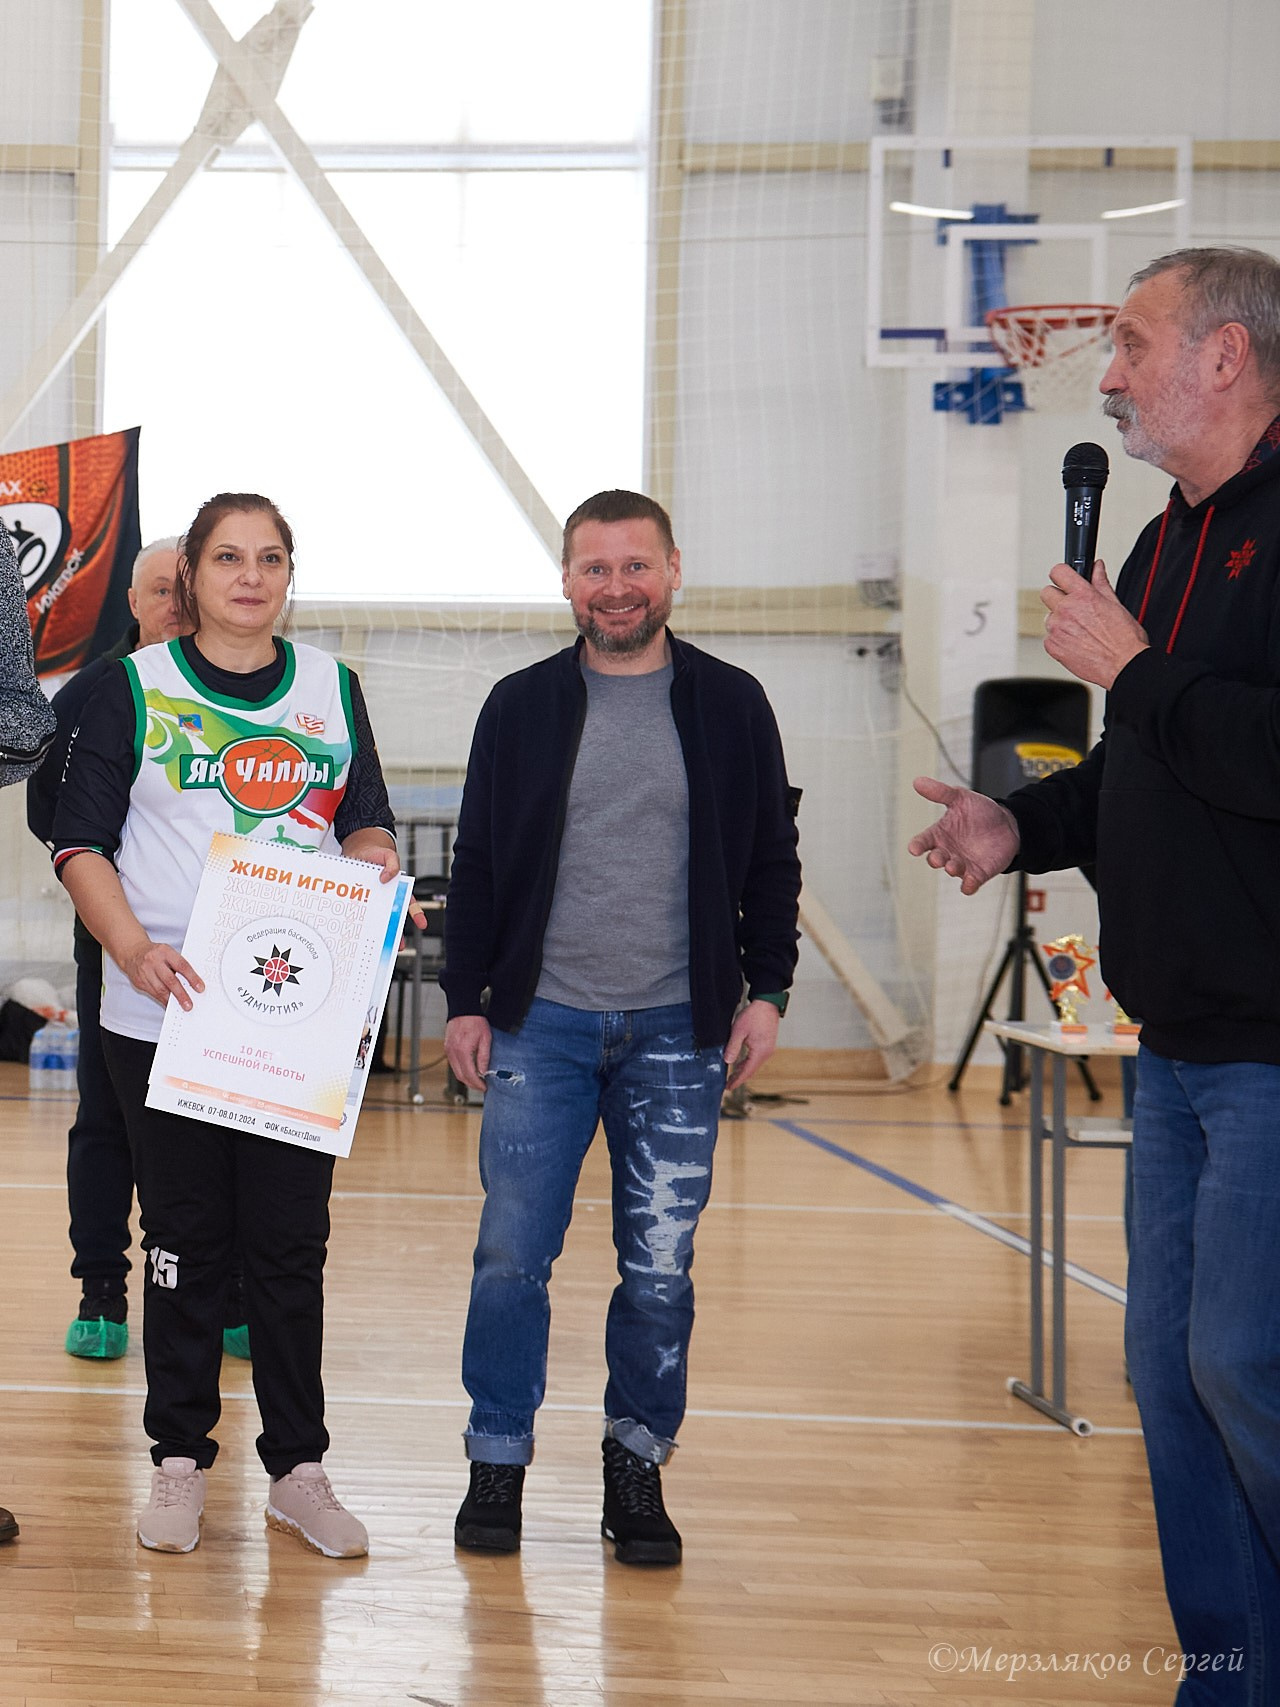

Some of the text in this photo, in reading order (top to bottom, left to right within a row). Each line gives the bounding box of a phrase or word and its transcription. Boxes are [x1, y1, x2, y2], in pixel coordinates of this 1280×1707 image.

[964, 600, 991, 636] 5
[224, 876, 368, 921] ЖИВИ ИГРОЙ!
[229, 859, 371, 903] ЖИВИ ИГРОЙ!
[246, 928, 319, 960] Федерация баскетбола
[237, 986, 304, 1015] «УДМУРТИЯ»
[202, 1048, 306, 1082] УСПЕШНОЙ РАБОТЫ
[240, 1045, 274, 1061] 10 ЛЕТ
[177, 1098, 204, 1113] ИЖЕВСК
[207, 1106, 256, 1126] 07-08.01.2024
[264, 1121, 280, 1133] ФОК
[150, 1246, 179, 1290] 15
